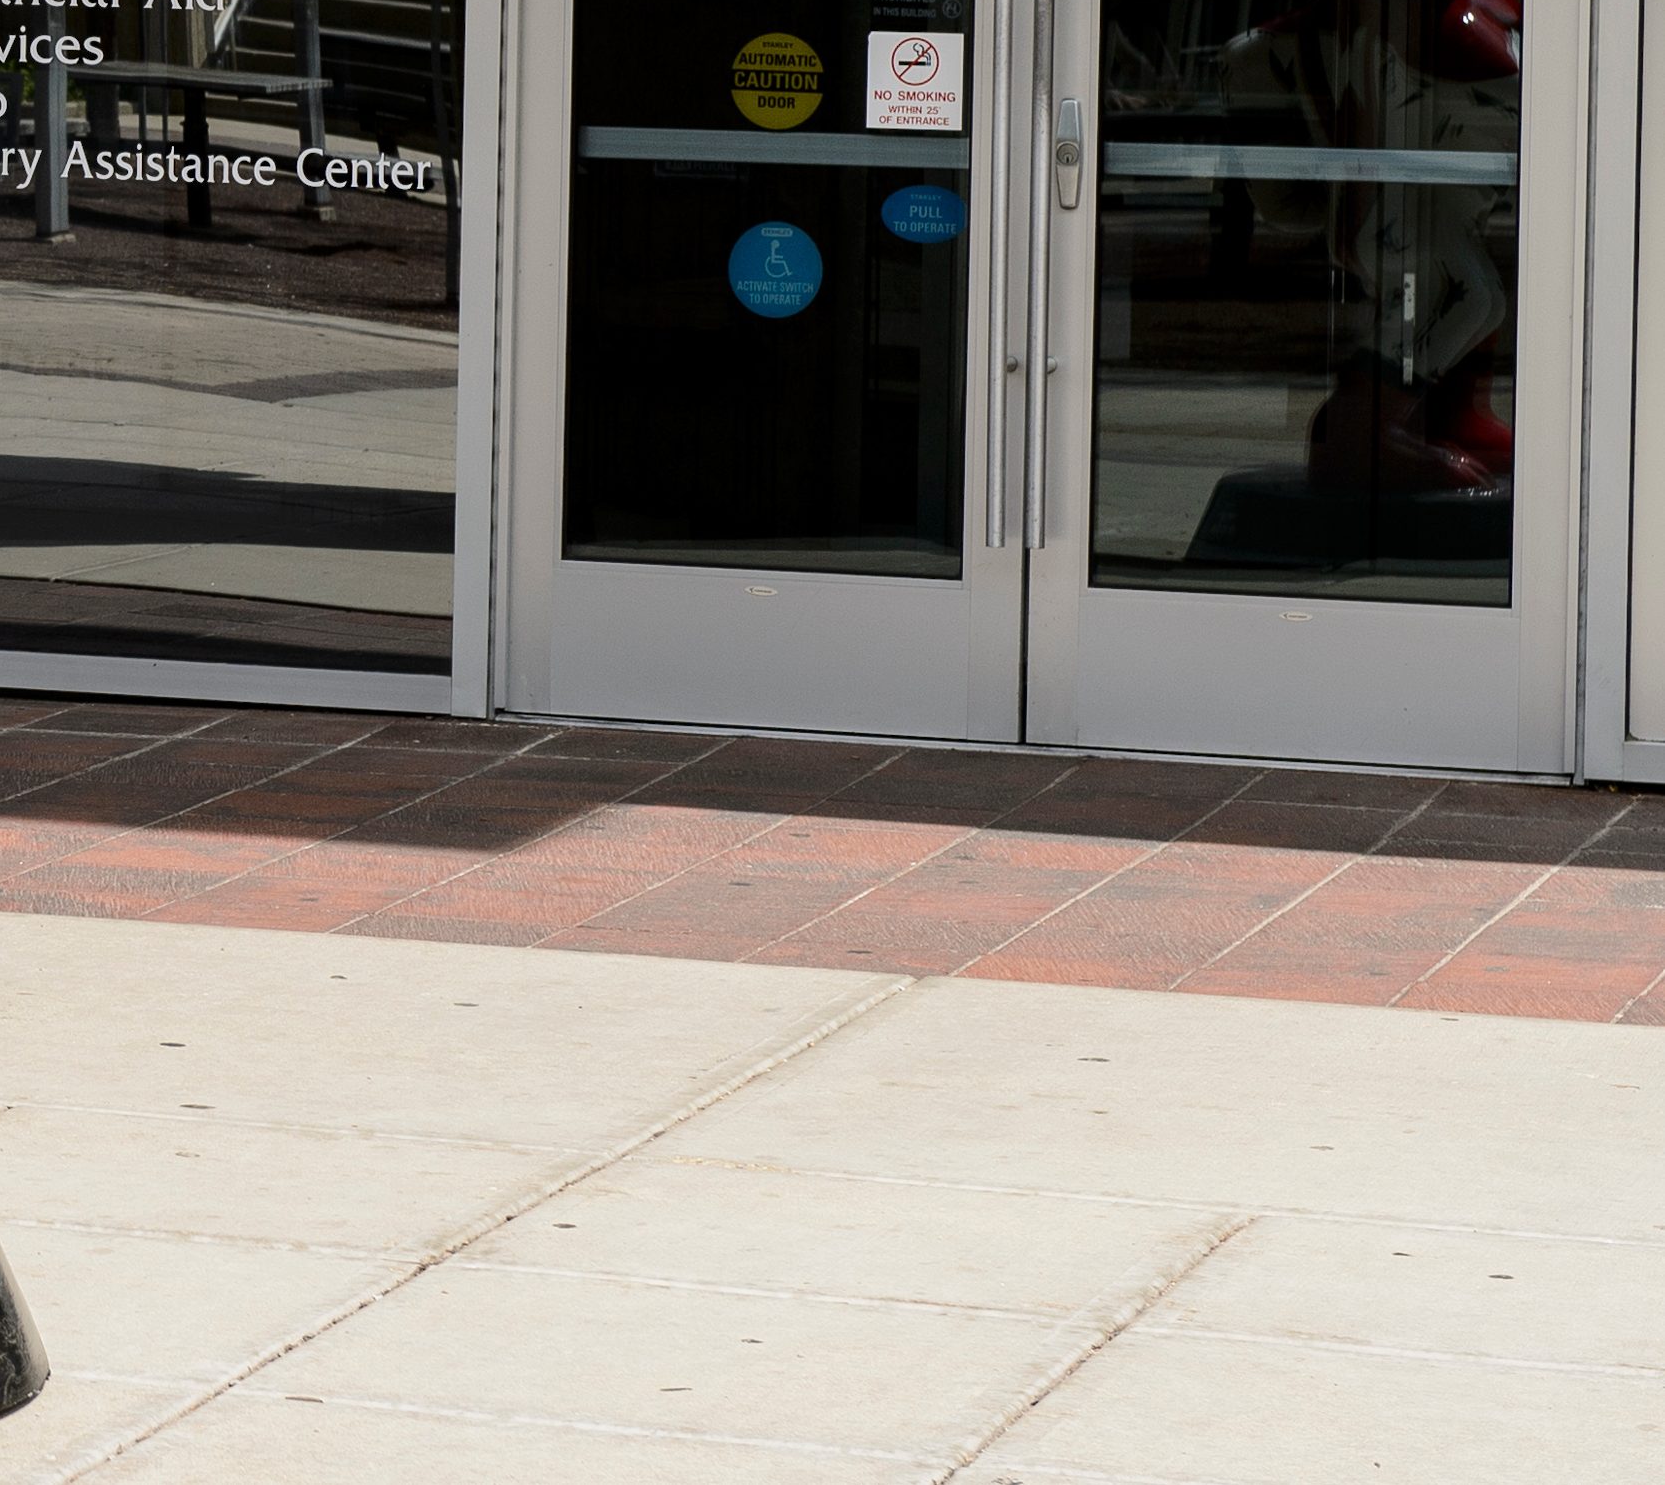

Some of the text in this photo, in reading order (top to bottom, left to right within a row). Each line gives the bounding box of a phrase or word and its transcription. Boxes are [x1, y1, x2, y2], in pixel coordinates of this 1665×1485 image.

[739, 52, 818, 68] AUTOMATIC
[734, 71, 819, 91] CAUTION
[757, 95, 796, 110] DOOR
[874, 90, 956, 103] NO SMOKING
[888, 105, 923, 115] WITHIN
[879, 115, 950, 126] OF ENTRANCE
[60, 140, 276, 187] Assistance
[295, 147, 431, 192] Center
[909, 205, 943, 219] PULL
[893, 221, 957, 234] TO OPERATE
[737, 281, 814, 294] ACTIVATE SWITCH
[749, 293, 802, 305] TO OPERATE
